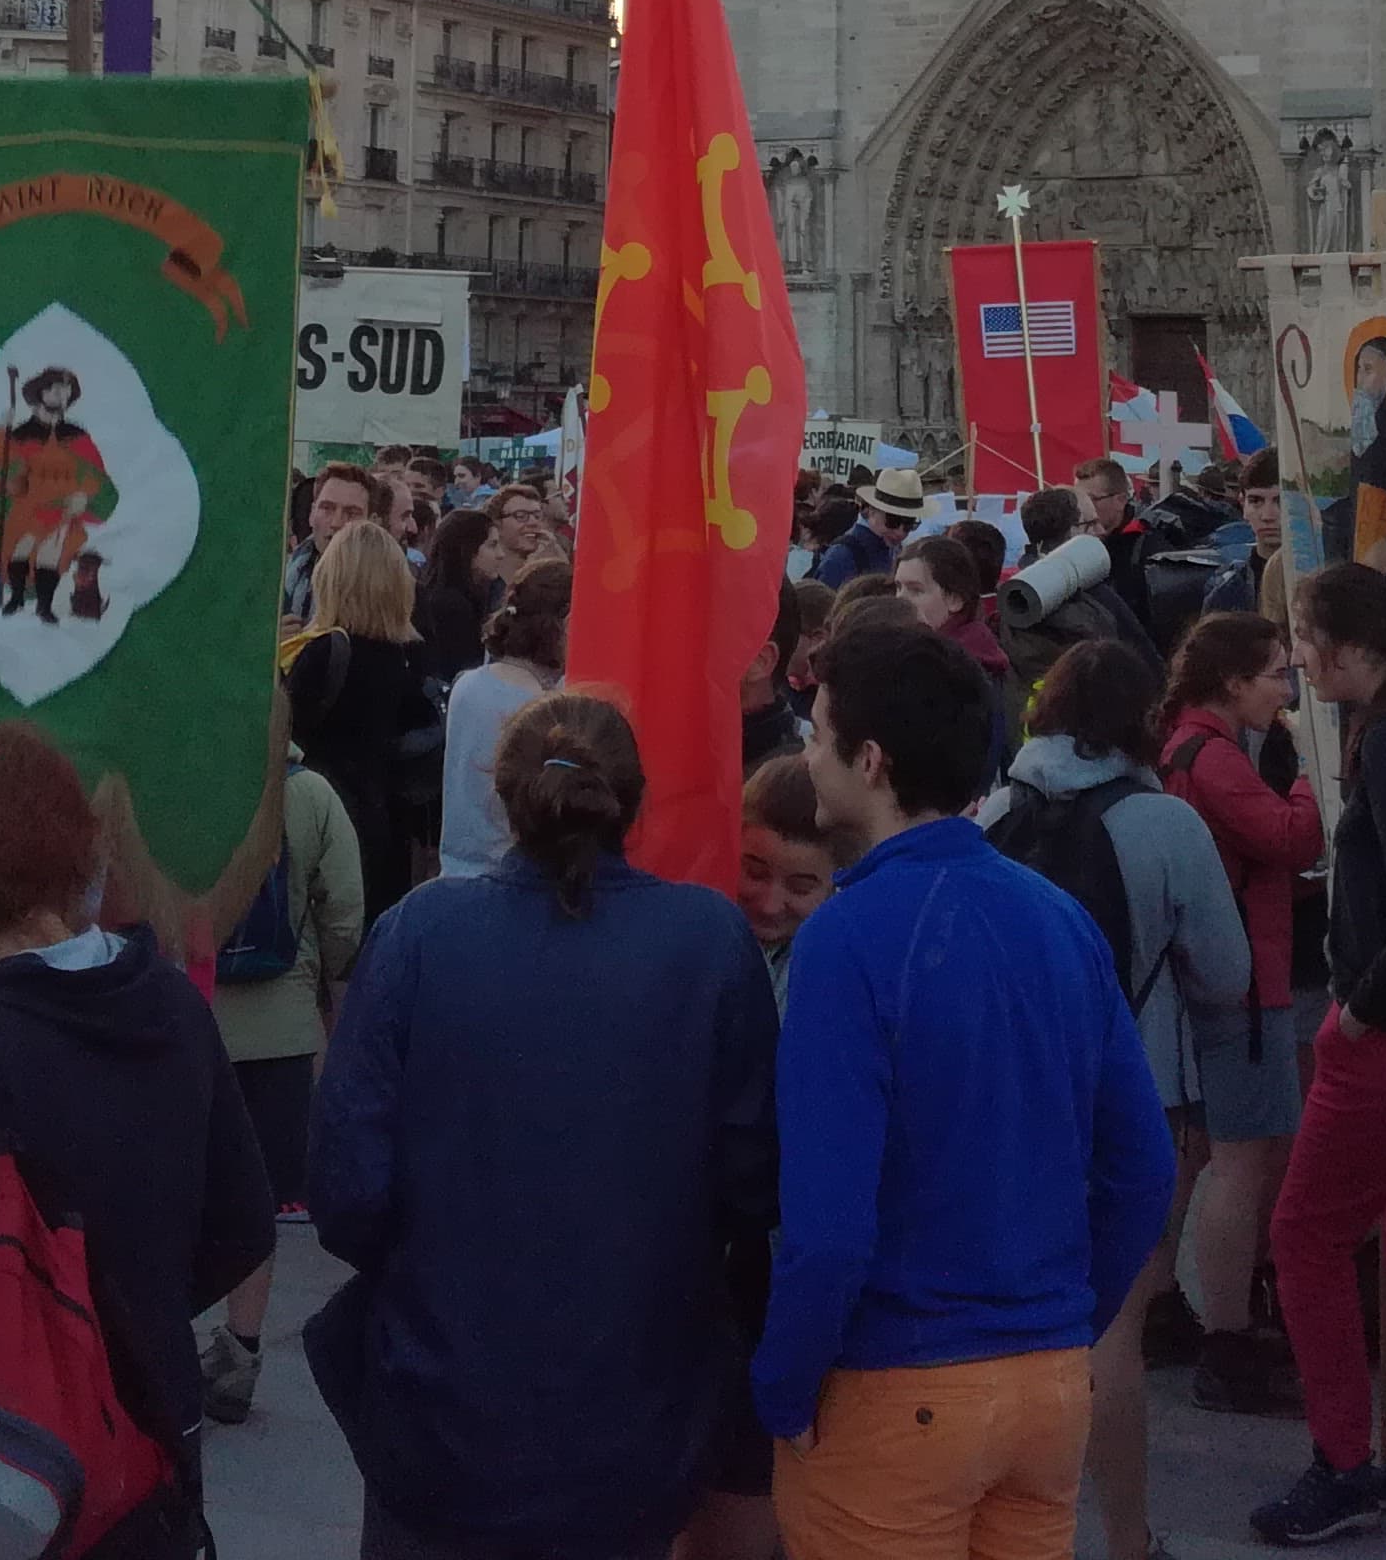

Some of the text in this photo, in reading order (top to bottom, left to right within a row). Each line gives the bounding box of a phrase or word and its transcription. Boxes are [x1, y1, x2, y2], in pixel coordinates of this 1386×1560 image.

[86, 173, 163, 224] ROCH
[297, 323, 445, 396] S-SUD
[802, 430, 876, 455] ECRETARIAT
